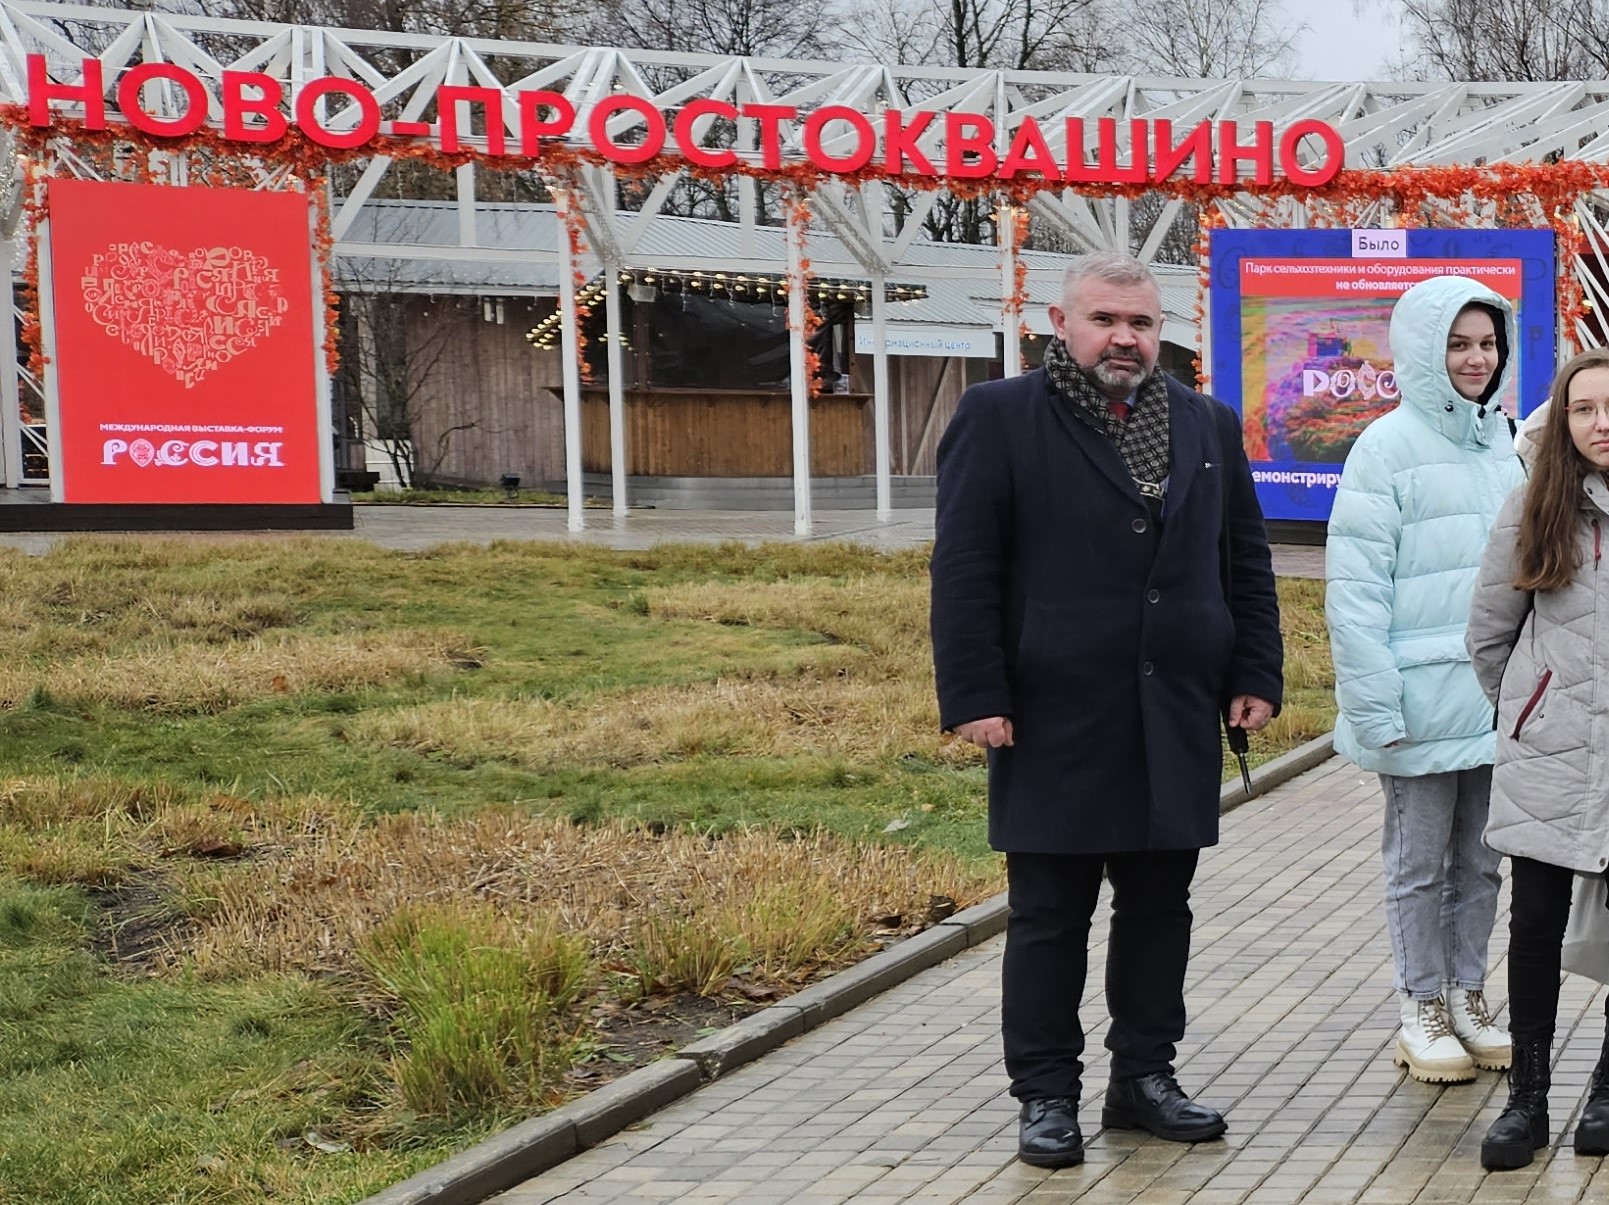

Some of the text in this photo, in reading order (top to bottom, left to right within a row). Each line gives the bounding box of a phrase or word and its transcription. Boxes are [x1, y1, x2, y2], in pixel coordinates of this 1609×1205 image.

[27, 53, 1345, 187] НОВО-ПРОСТОКВАШИНО
[1358, 236, 1400, 251] Было
[1245, 262, 1516, 277] Парк сельхозтехники и оборудования практически
[1335, 281, 1350, 290] не
[944, 341, 971, 353] центр
[100, 423, 283, 434] МЕЖДУНАРОДНАЯ ВЫСТАВКА-ФОРУМ
[100, 438, 285, 467] РОССИЯ
